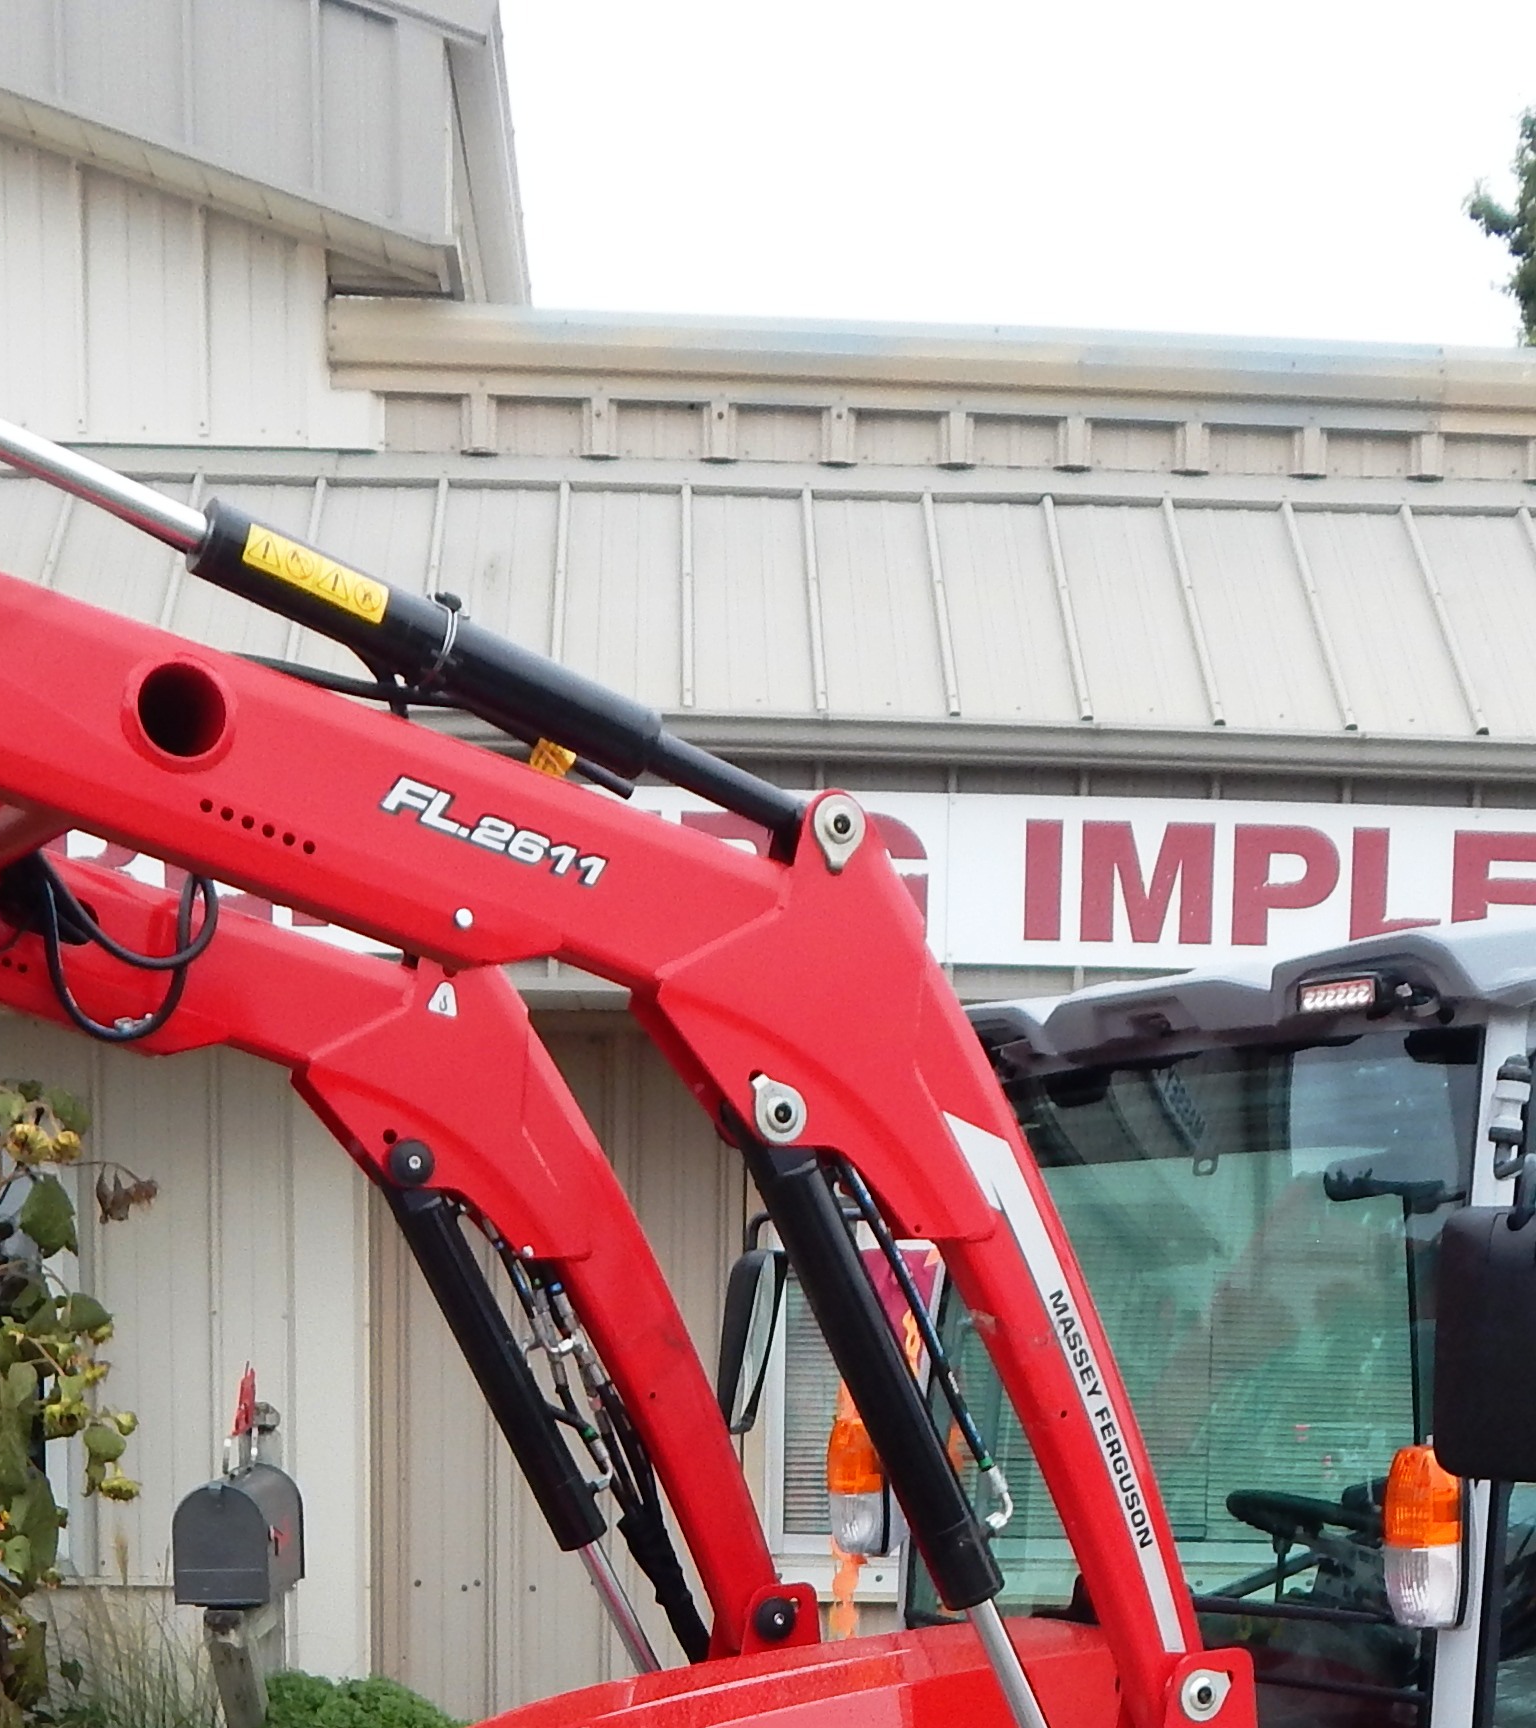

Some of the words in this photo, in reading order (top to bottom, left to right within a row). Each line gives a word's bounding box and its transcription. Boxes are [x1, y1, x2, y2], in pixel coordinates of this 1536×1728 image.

[380, 774, 609, 887] FL.2611
[1049, 1289, 1102, 1397] MASSEY
[1095, 1406, 1154, 1549] FERGUSON
